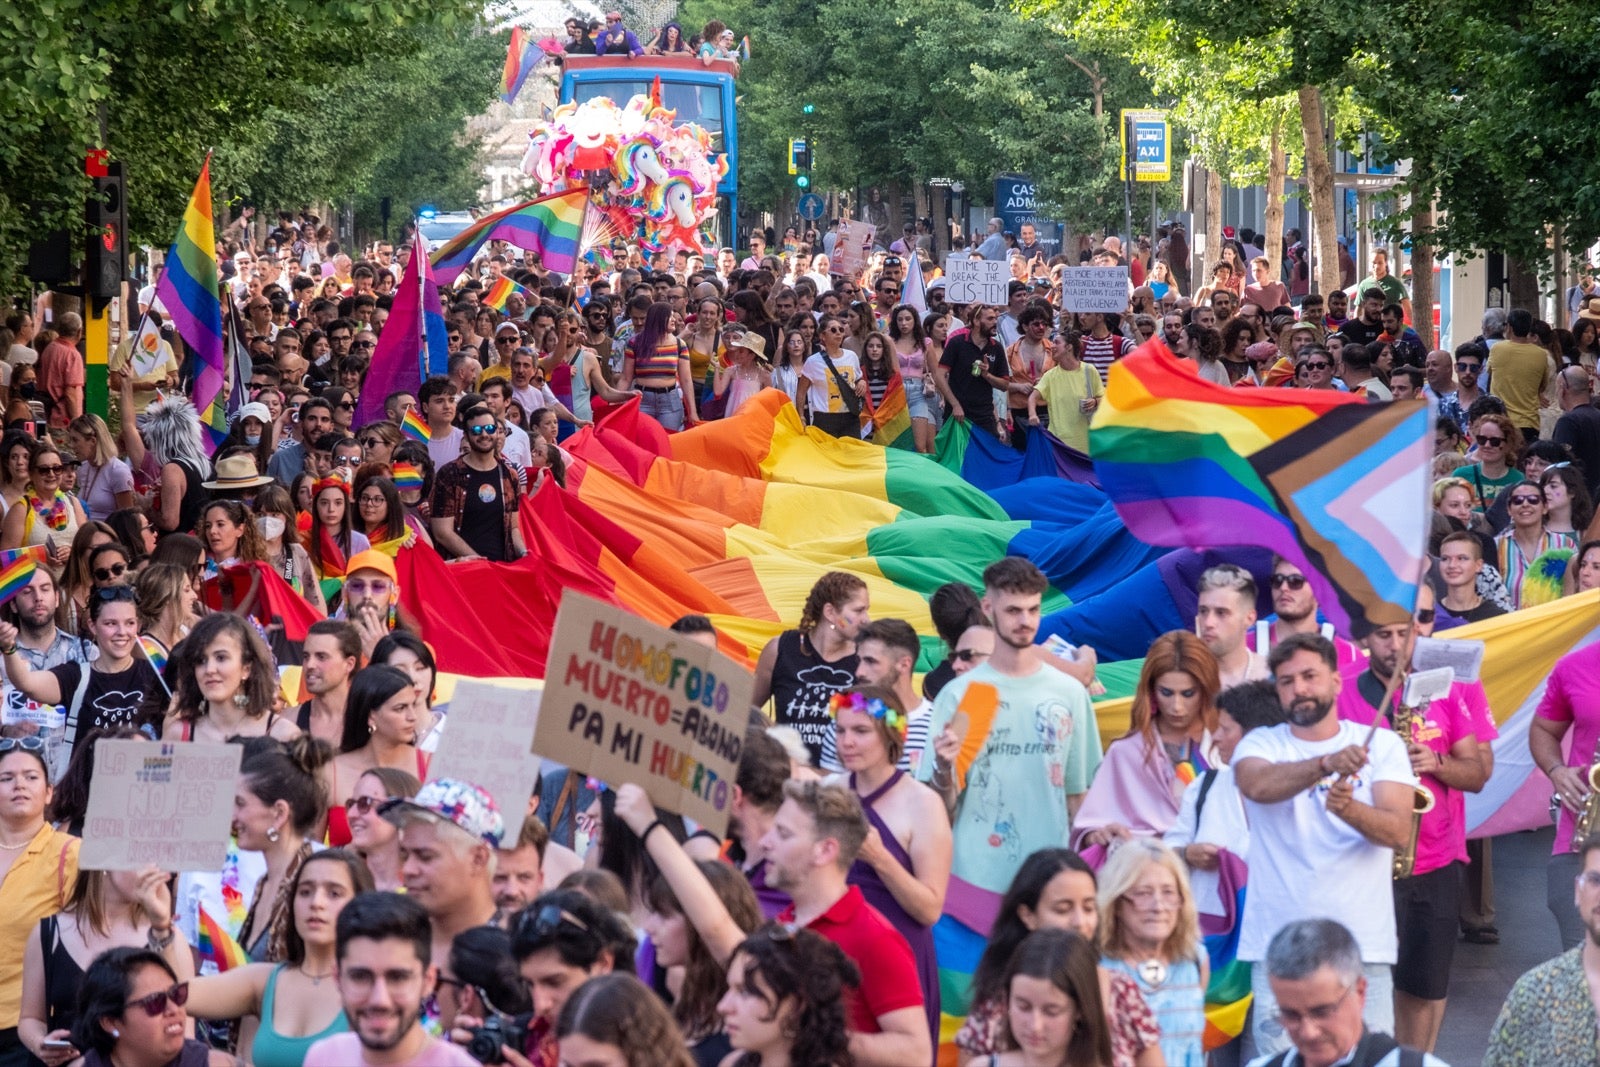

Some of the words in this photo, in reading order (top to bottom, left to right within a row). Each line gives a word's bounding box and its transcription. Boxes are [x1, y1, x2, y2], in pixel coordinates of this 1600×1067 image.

[1137, 146, 1159, 157] AXI
[1012, 184, 1036, 195] CAS
[953, 261, 979, 271] TIME
[986, 262, 998, 271] TO
[1064, 270, 1073, 278] EL
[1107, 270, 1115, 278] SE
[1117, 270, 1126, 278] HA
[951, 272, 980, 282] BREAK
[984, 272, 1000, 282] THE
[949, 282, 1007, 304] CIS-TEM
[284, 558, 293, 580] BIMBA
[590, 620, 729, 713] HOMÓFOBO
[568, 703, 604, 745] PA
[611, 722, 643, 764] MI
[649, 740, 729, 811] HUERTO
[127, 783, 166, 818] NO
[175, 782, 216, 817] ES
